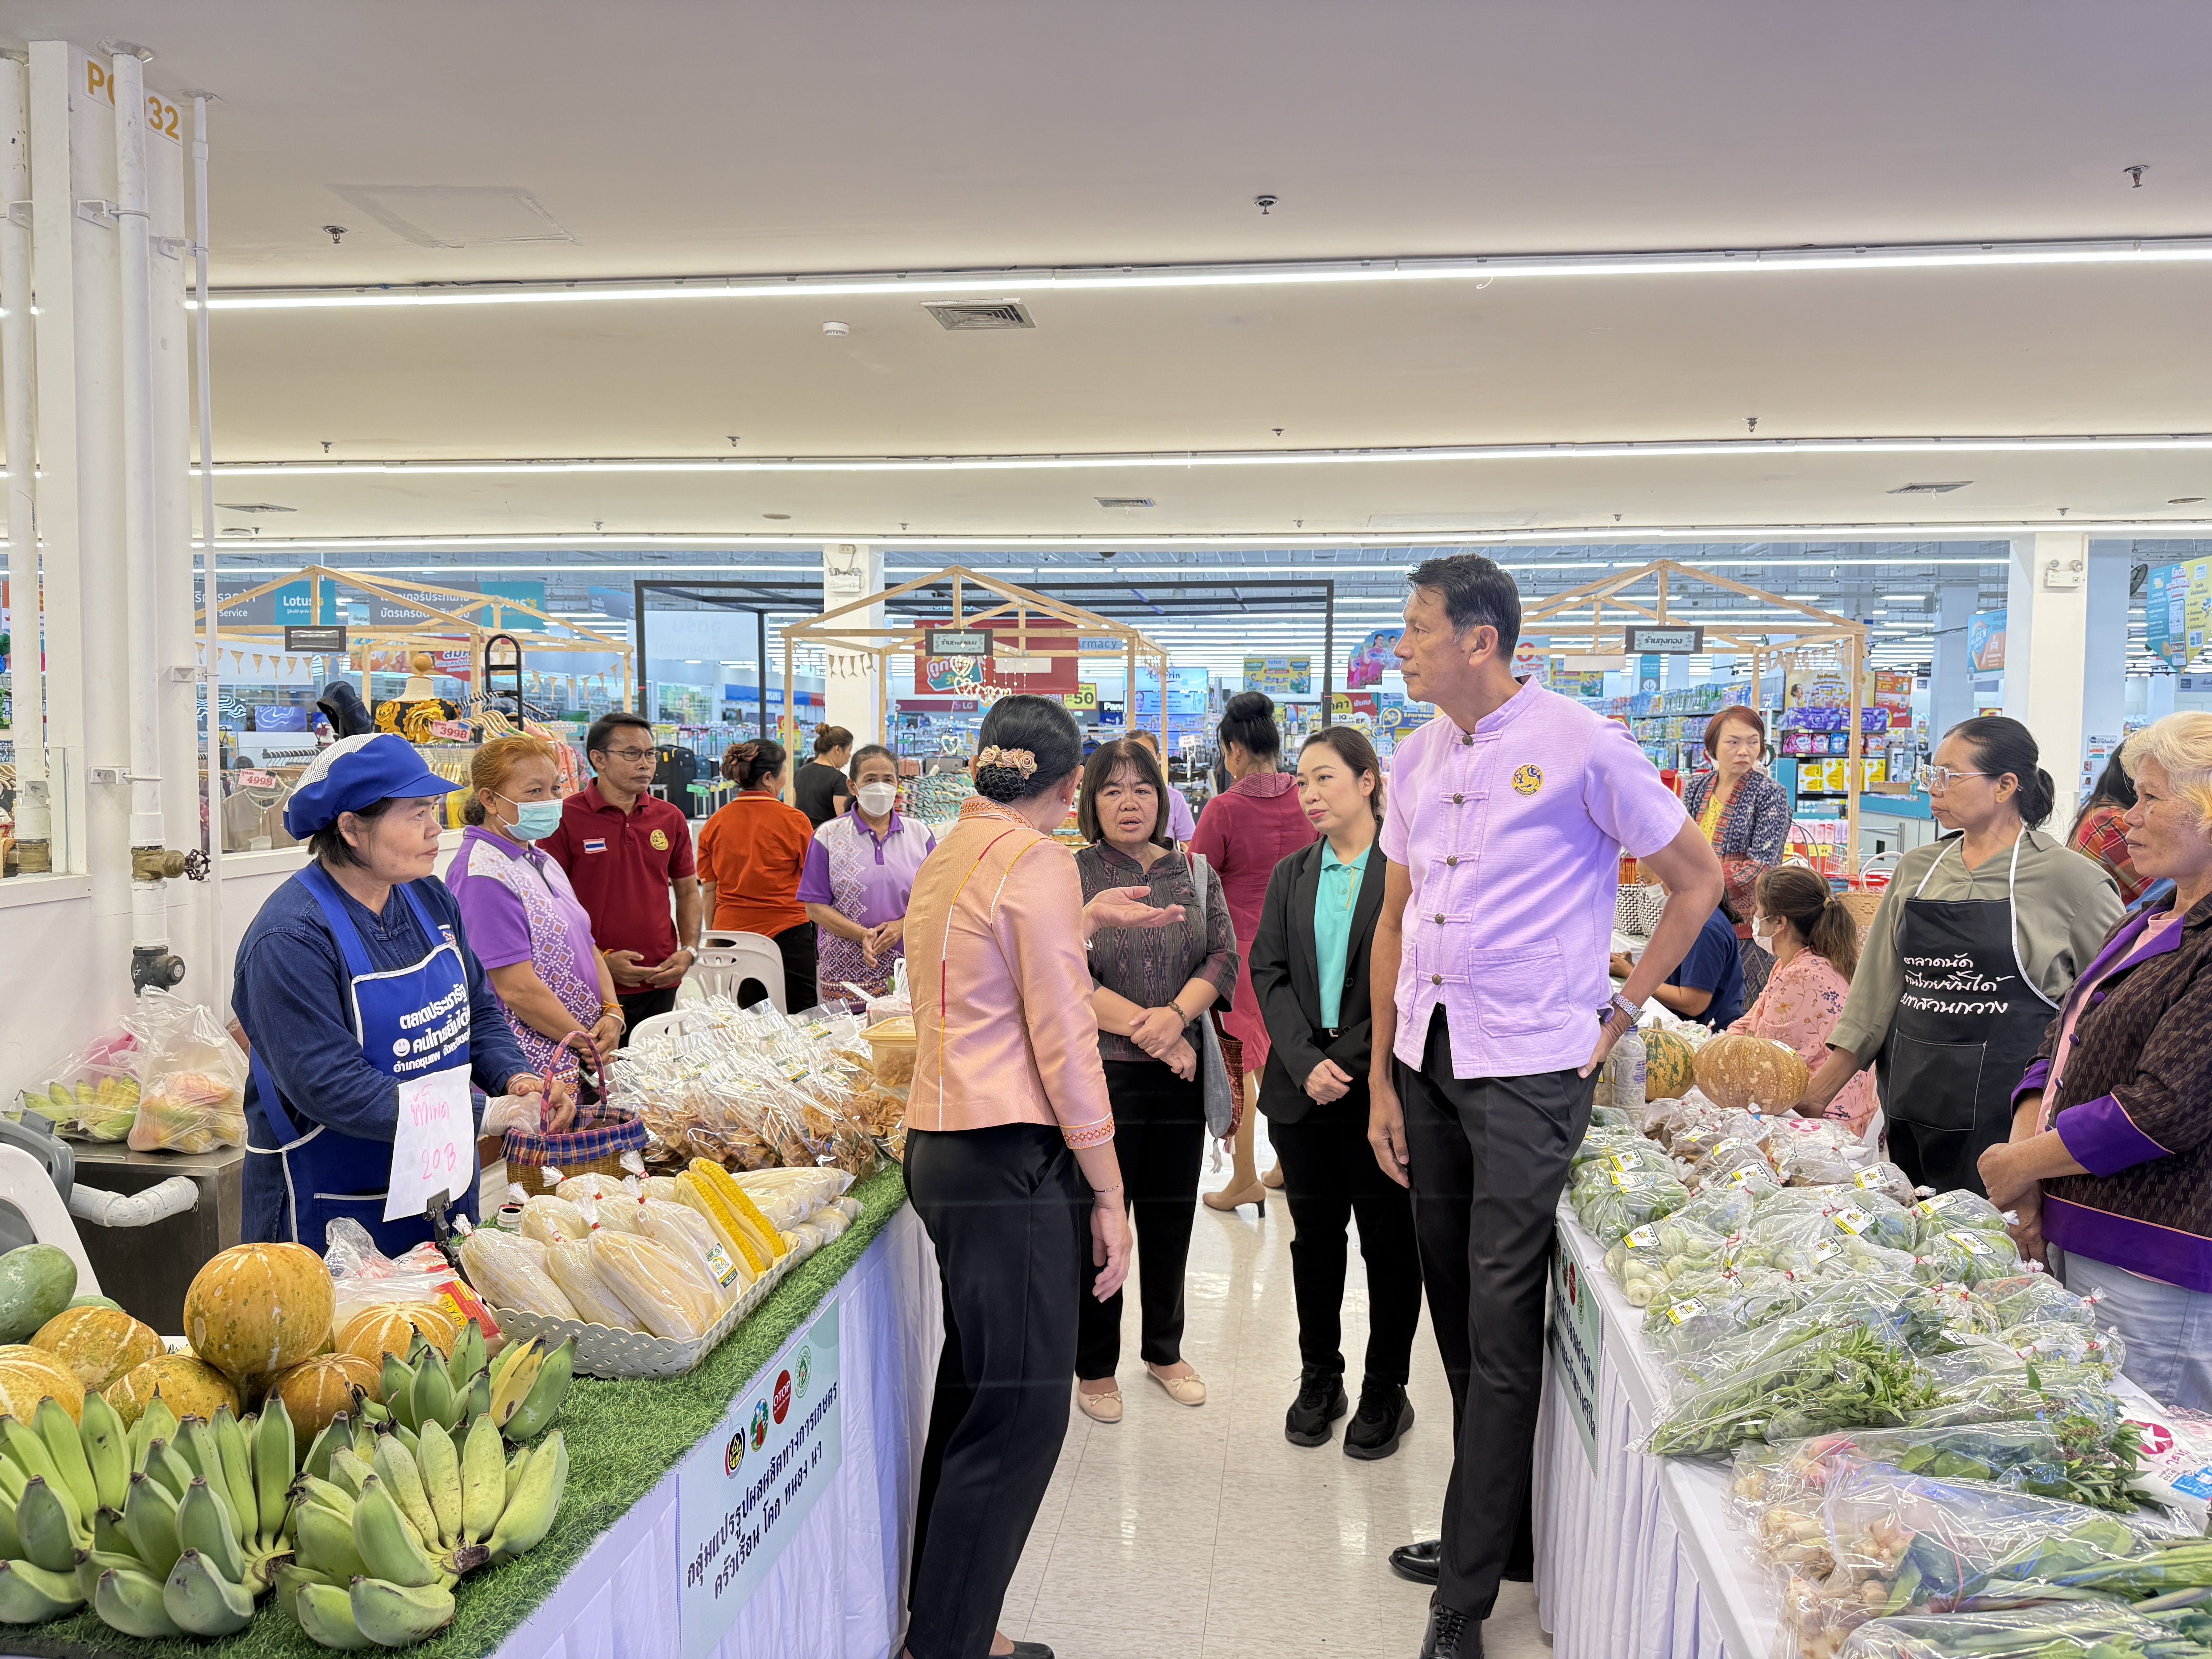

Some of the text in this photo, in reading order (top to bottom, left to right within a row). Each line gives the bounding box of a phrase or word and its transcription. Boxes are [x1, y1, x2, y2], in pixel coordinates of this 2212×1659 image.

[219, 609, 248, 617] Service
[1644, 635, 1683, 646] ร้านถุงทอง
[1073, 692, 1094, 704] 50
[1903, 952, 1973, 968] ตลาดนัด
[1905, 970, 2015, 991] คนไทยยิ้มได้
[400, 983, 468, 1030] ตลาดประชารัฐ
[393, 1051, 440, 1073] อำเภอชุมแพ
[421, 1148, 441, 1180] 20
[773, 1379, 791, 1407] OTOP
[687, 1380, 838, 1589] กลุ่มแปรรูปผลผลิตทางการเกษตร
[714, 1440, 822, 1600] ครัวเรือน โคก หนอง นา
